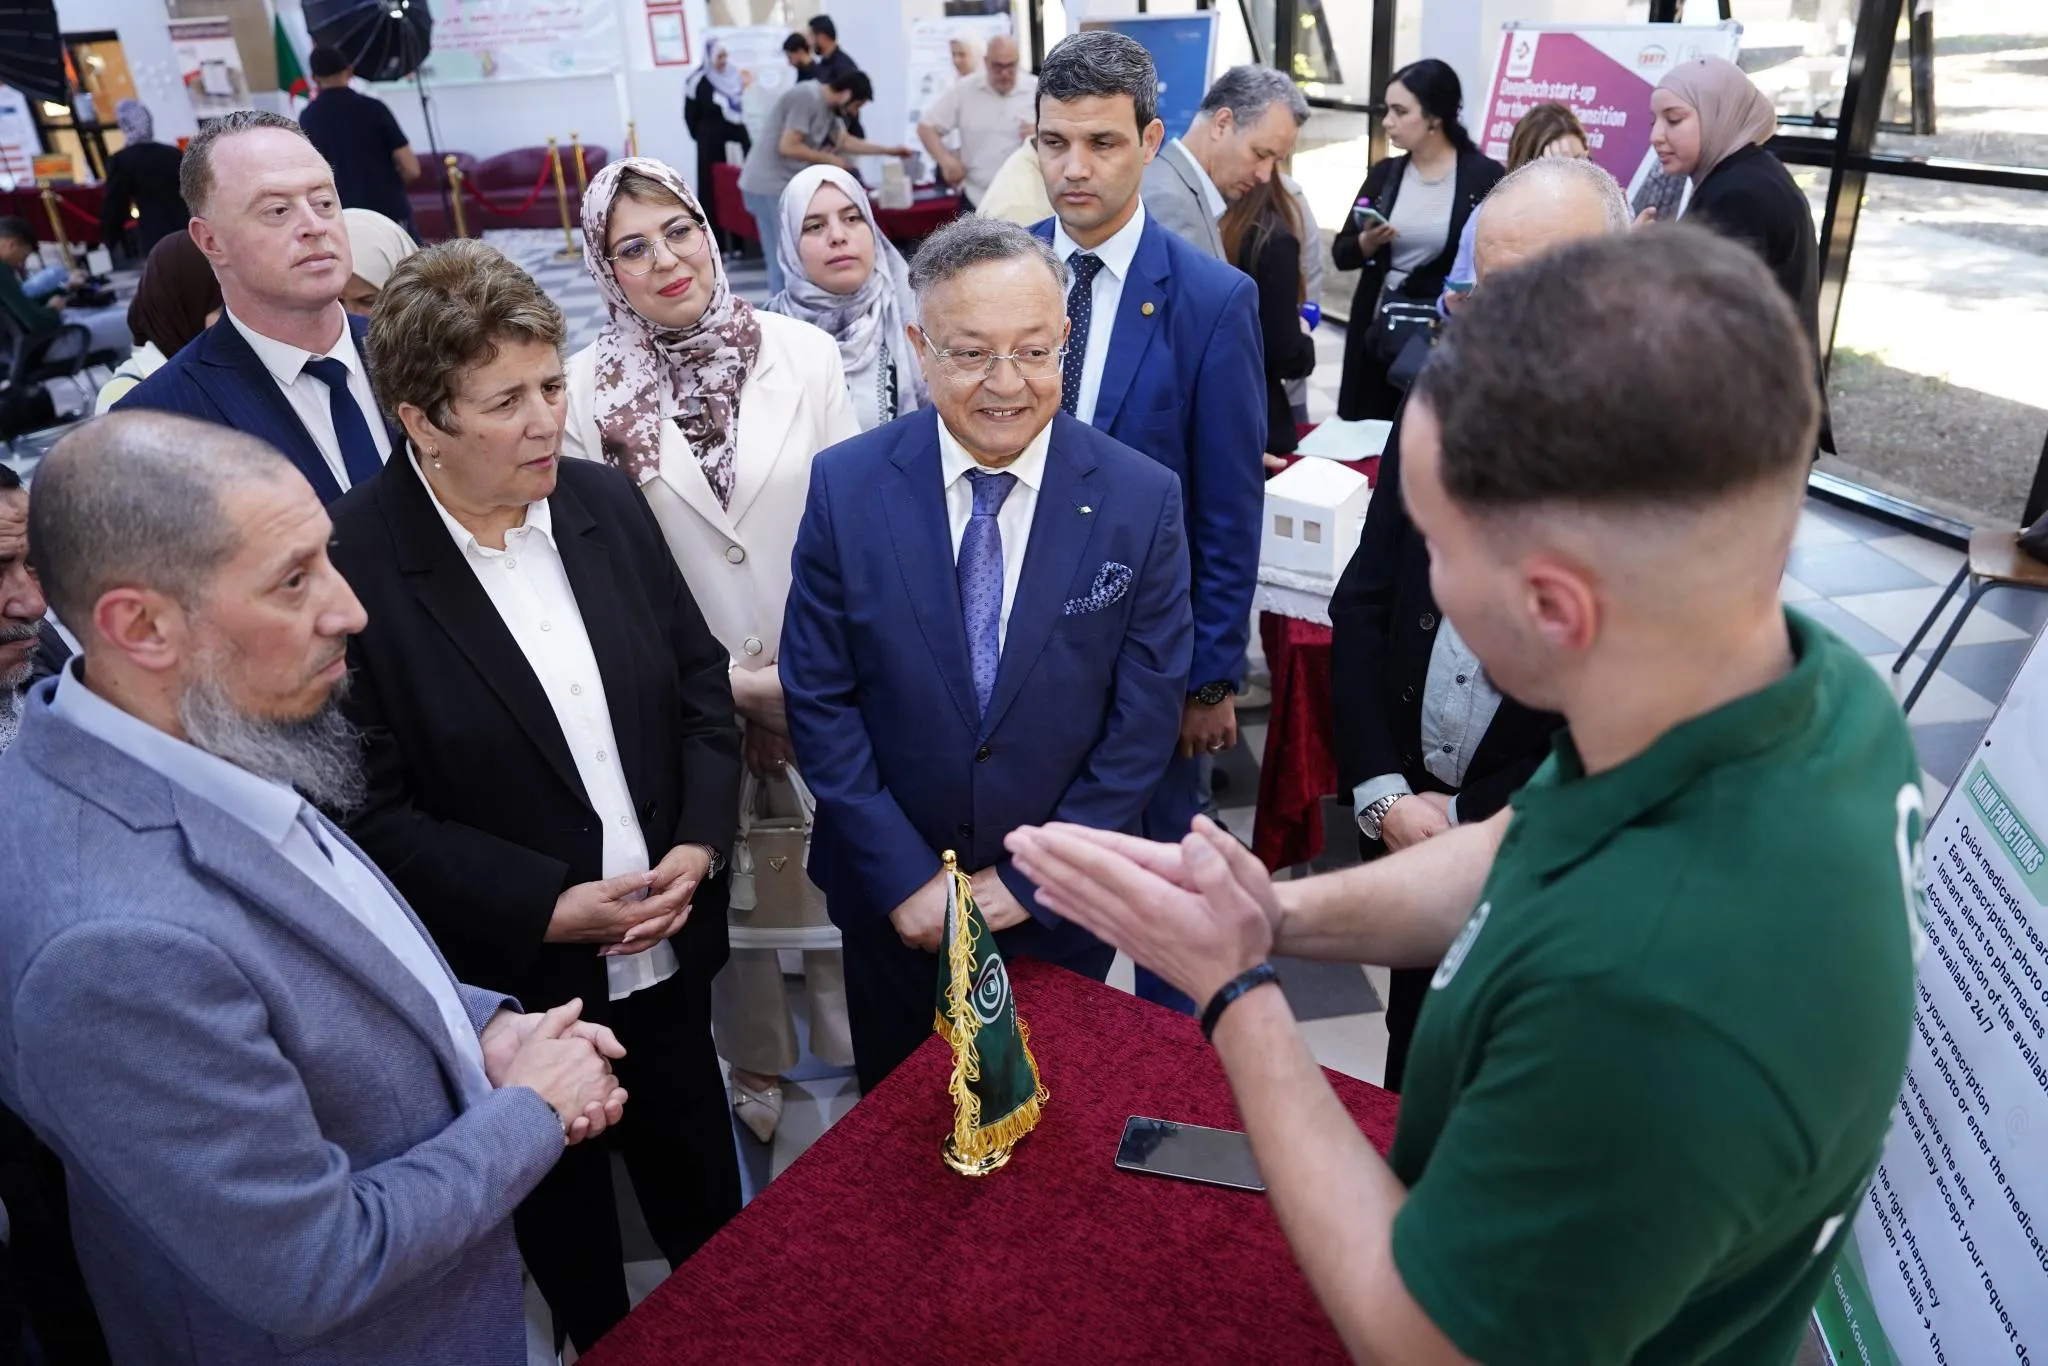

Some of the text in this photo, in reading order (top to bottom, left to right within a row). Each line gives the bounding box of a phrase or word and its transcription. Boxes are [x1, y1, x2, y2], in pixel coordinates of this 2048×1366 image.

[1548, 82, 1596, 105] start-up
[1961, 826, 1982, 861] Quick
[1980, 859, 2027, 928] medication
[1970, 771, 2045, 875] MAIN FONCTIONS
[1926, 883, 1958, 937] Accurate
[1956, 932, 1989, 990] location
[1988, 989, 2002, 1005] of
[1998, 1003, 2014, 1031] the
[1937, 863, 2045, 1039] Instant alerts to pharmacies
[1949, 844, 1967, 874] Easy
[1962, 871, 2015, 950] prescription:
[2012, 948, 2042, 991] photo
[1937, 945, 1972, 1002] available
[1970, 1000, 1994, 1034] 24/7
[1926, 1001, 1946, 1031] your
[1941, 1031, 1990, 1115] prescription
[1912, 1006, 2048, 1278] pload a photo or enter the medicatio
[1915, 1092, 1943, 1144] receive
[1941, 1143, 1956, 1171] the
[1953, 1172, 1975, 1210] alert
[1869, 1185, 1897, 1248] location
[1898, 1260, 1924, 1315] details
[1878, 1165, 1940, 1308] the right pharmacy
[1898, 1093, 1925, 1144] several
[1920, 1143, 1939, 1175] may
[1936, 1175, 1965, 1231] accept
[1959, 1230, 1984, 1268] your
[1981, 1270, 2018, 1342] request
